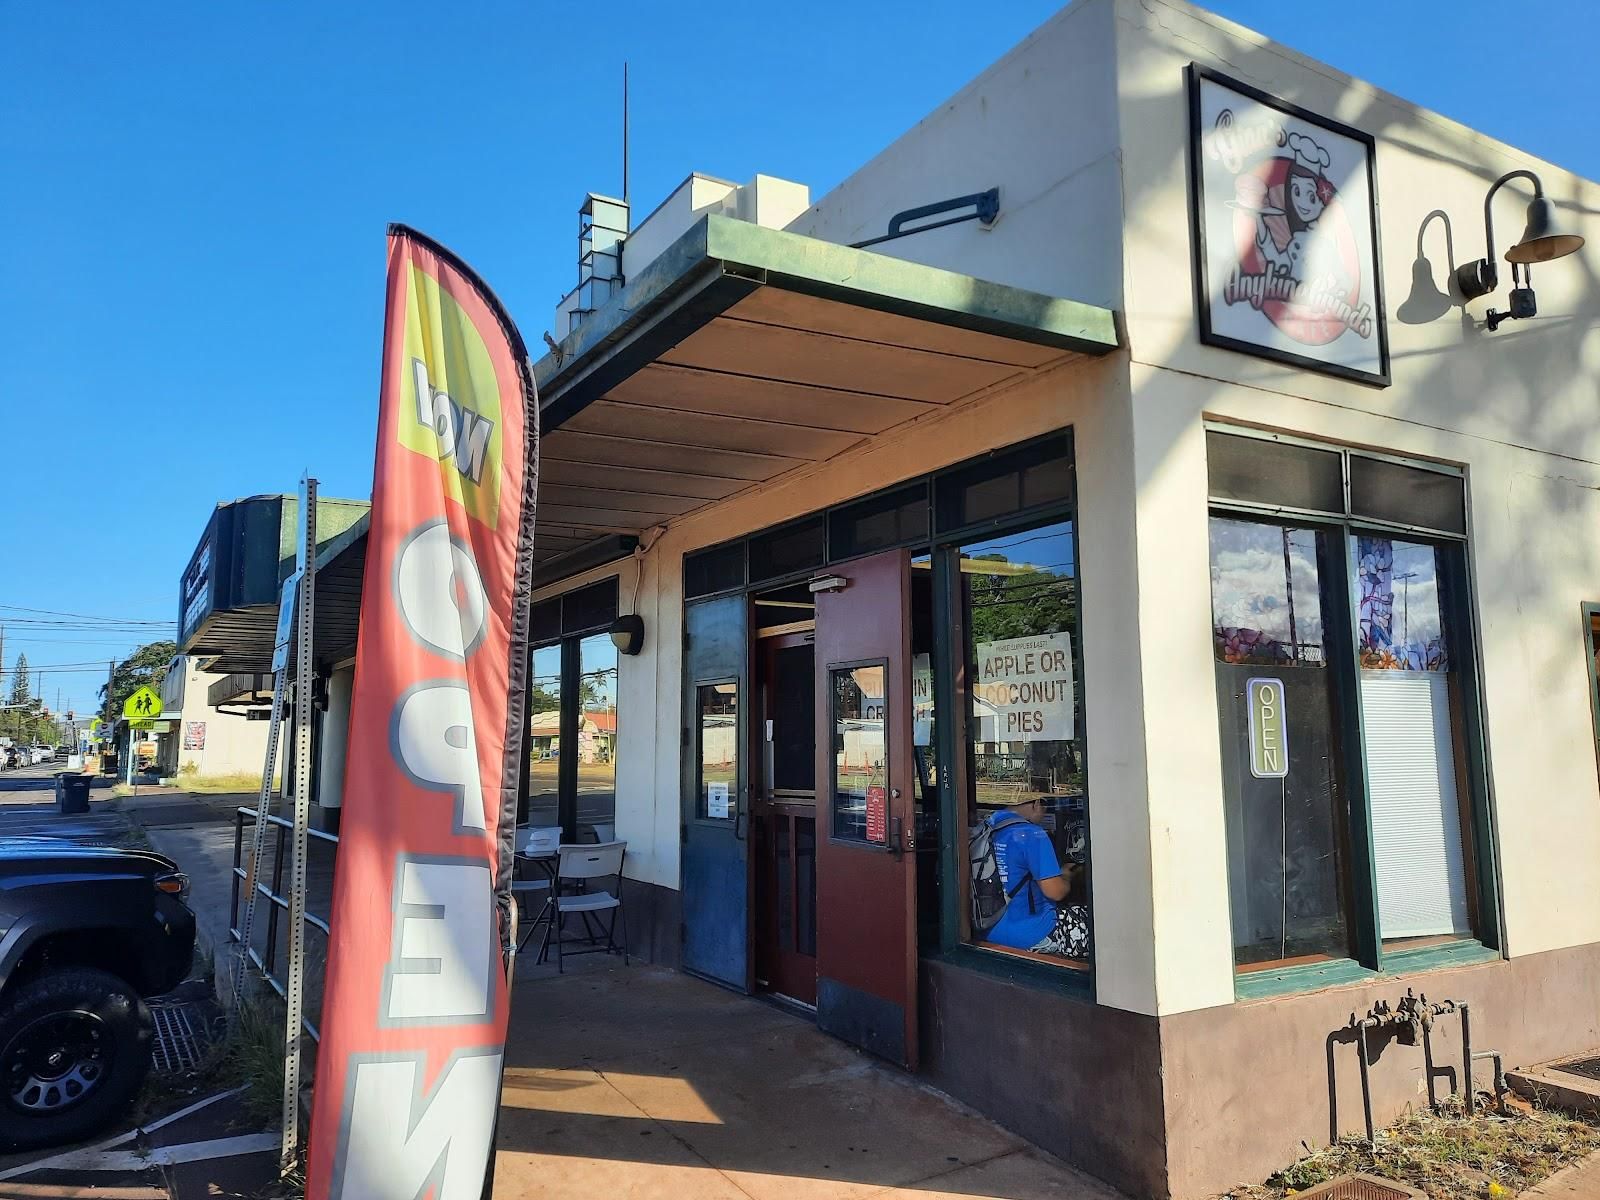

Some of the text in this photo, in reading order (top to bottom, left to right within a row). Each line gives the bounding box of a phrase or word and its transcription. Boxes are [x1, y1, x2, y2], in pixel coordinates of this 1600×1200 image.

[984, 650, 1066, 679] APPLE OR
[986, 679, 1067, 705] COCONUT
[1007, 710, 1044, 733] PIES
[1259, 684, 1278, 772] OPEN
